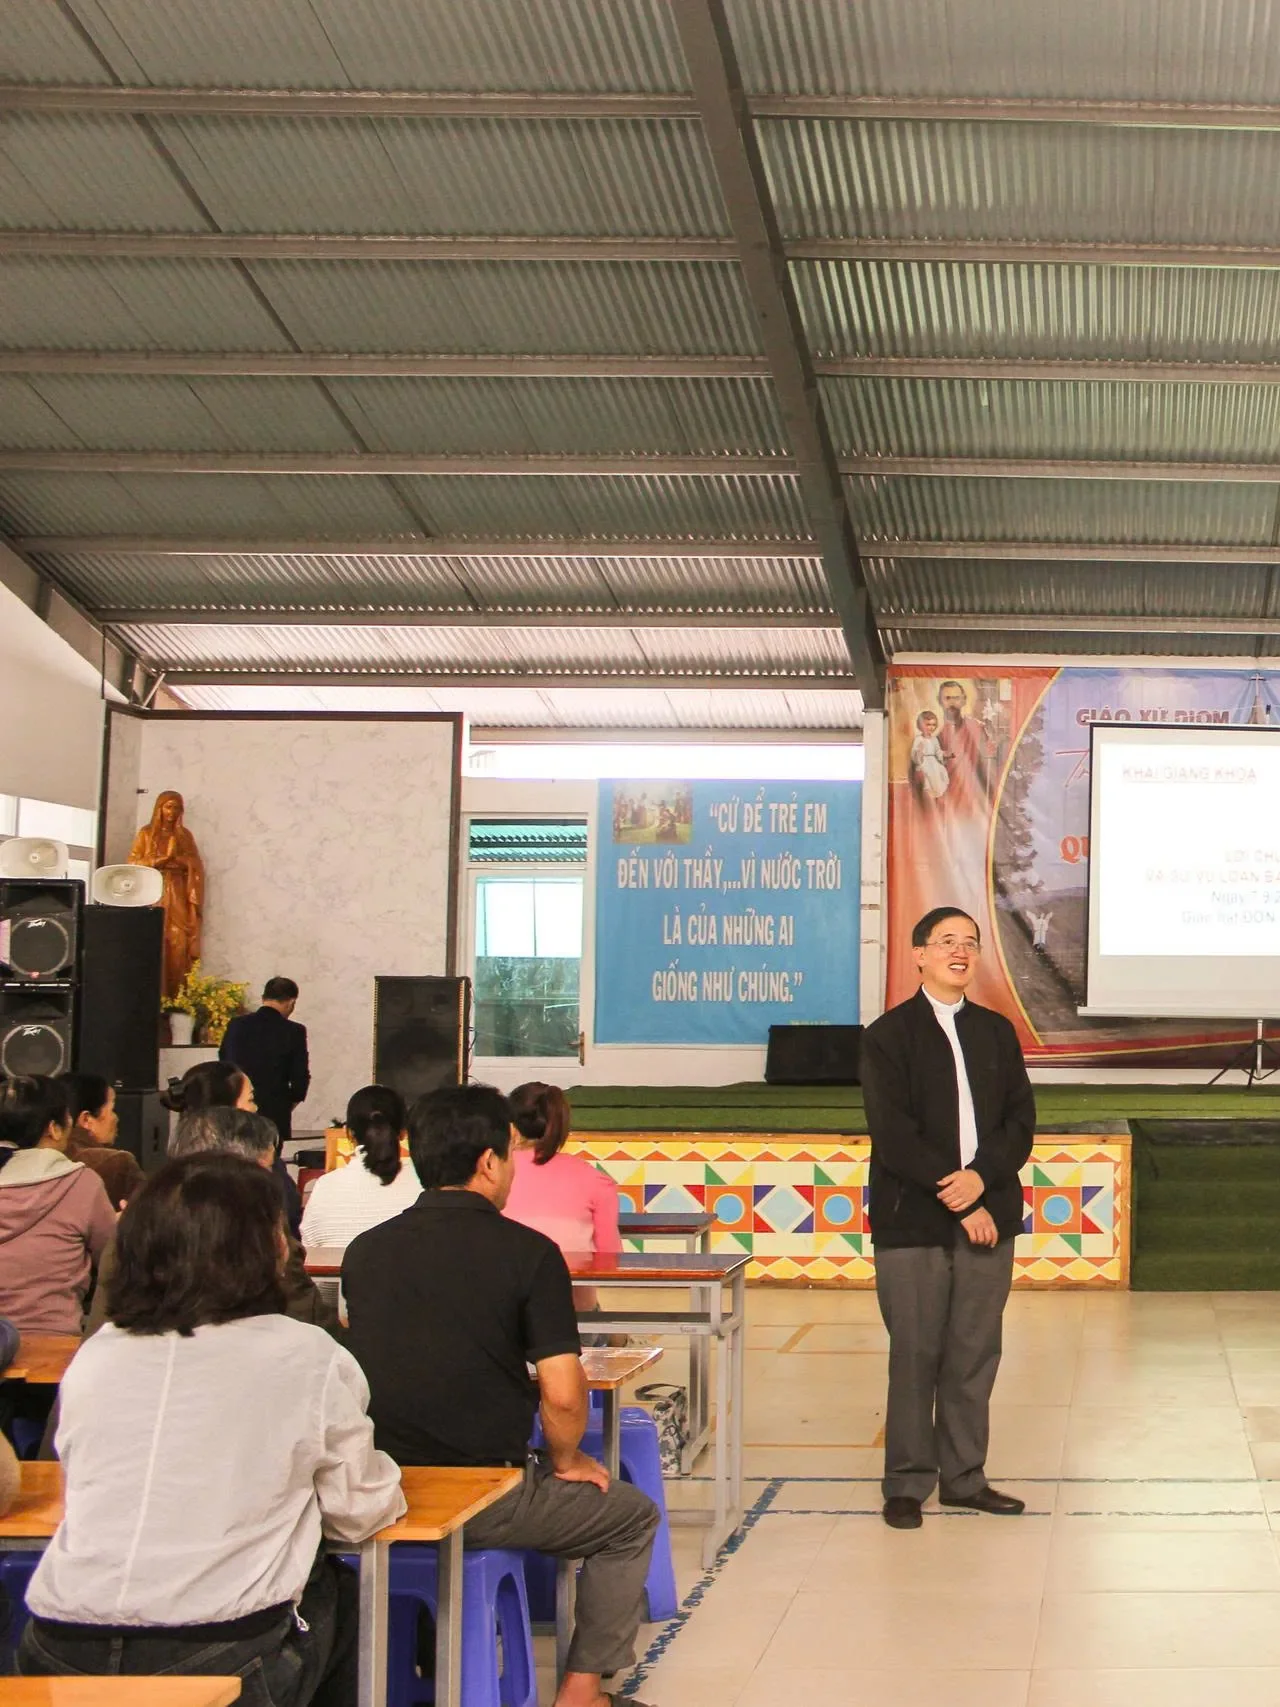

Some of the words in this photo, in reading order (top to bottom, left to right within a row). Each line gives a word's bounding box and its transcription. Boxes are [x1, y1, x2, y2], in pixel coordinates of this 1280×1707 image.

[743, 786, 765, 833] ĐỂ
[769, 791, 798, 833] TRẺ
[804, 803, 827, 833] EM
[618, 846, 648, 889] ĐẾN
[654, 850, 678, 889] VỚI
[761, 851, 801, 889] NƯỚC
[806, 850, 841, 889] TRỜI
[664, 906, 682, 945] LÀ
[688, 903, 717, 945] CỦA
[723, 907, 774, 946] NHỮNG
[779, 915, 794, 946] AI
[652, 958, 698, 1002] GIỐNG
[703, 966, 735, 1002] NHƯ
